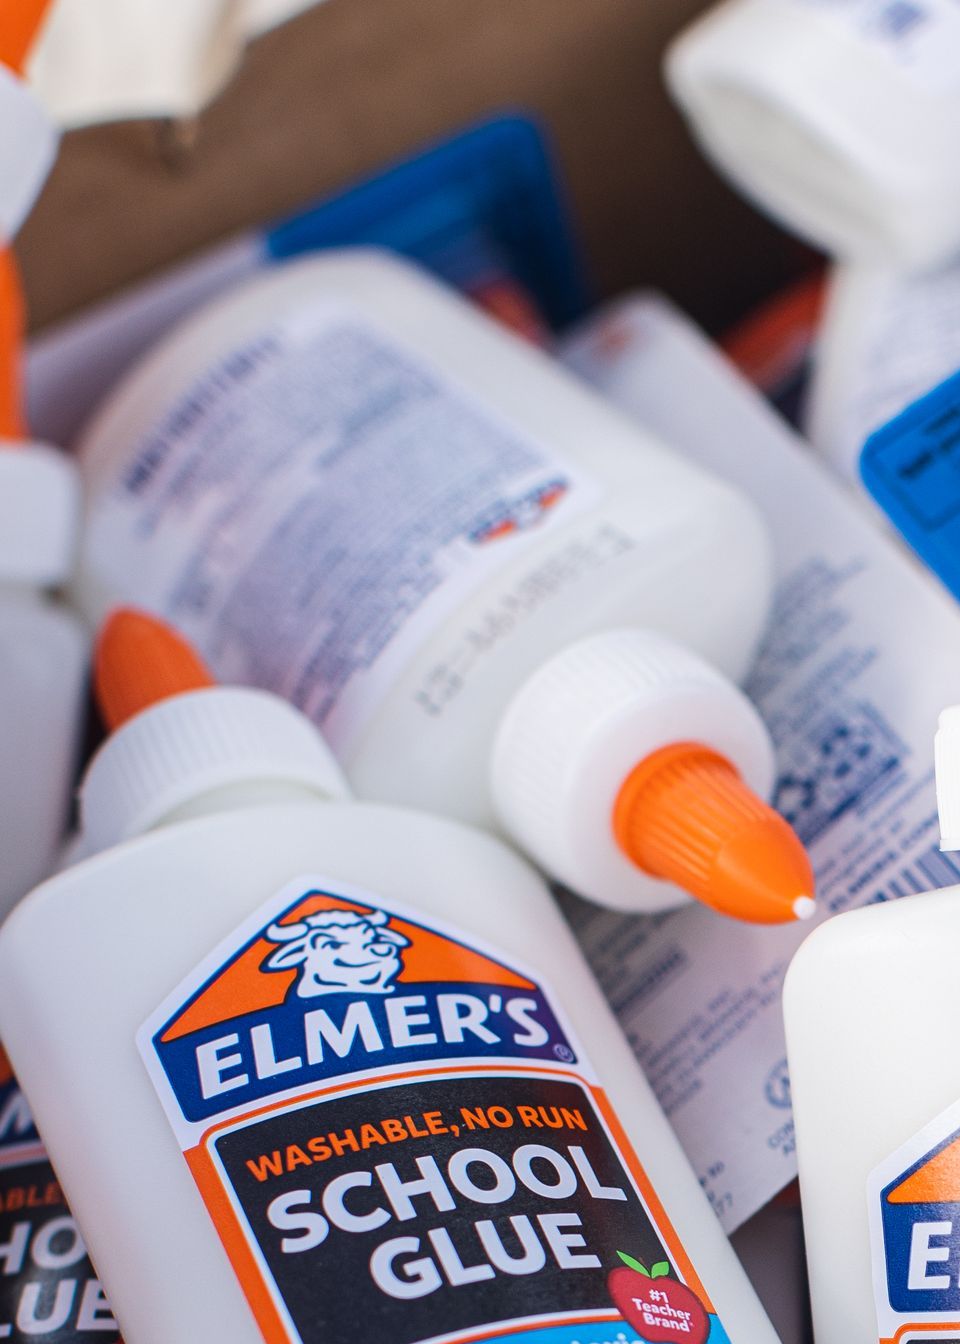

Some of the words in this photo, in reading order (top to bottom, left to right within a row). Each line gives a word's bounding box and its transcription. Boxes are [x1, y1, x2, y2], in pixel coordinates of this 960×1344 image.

[195, 994, 549, 1100] ELMER'S
[246, 1107, 461, 1182] WASHABLE,
[463, 1104, 513, 1137] NO
[516, 1103, 588, 1133] RUN
[266, 1143, 628, 1254] SCHOOL
[369, 1211, 602, 1300] GLUE
[649, 1287, 669, 1303] #1
[632, 1297, 691, 1321] Teacher
[643, 1311, 690, 1333] Brand
